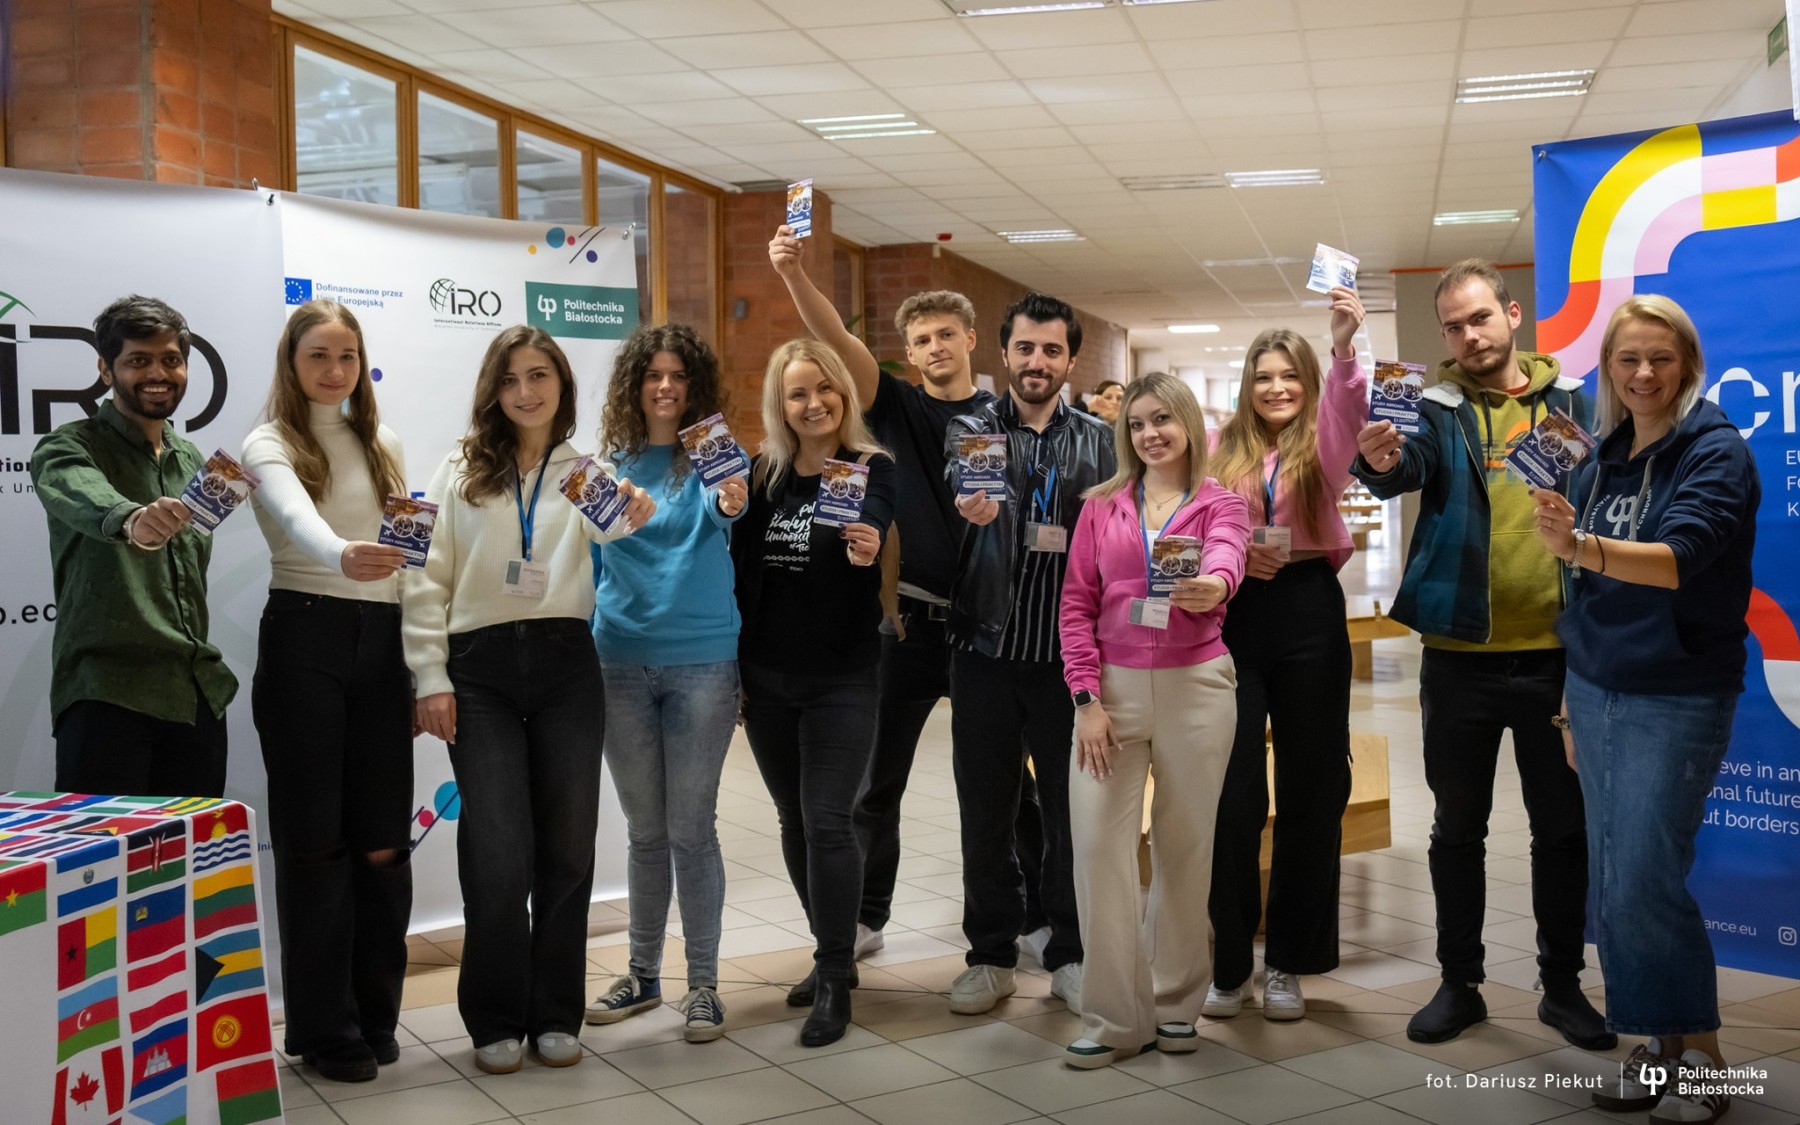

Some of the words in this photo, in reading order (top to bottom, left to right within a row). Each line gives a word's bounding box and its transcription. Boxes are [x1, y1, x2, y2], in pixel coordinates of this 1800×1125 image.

[316, 282, 380, 296] Dofinansowane
[381, 290, 403, 298] przez
[337, 295, 384, 308] Europejską
[564, 299, 625, 312] Politechnika
[565, 311, 623, 324] Białostocka
[1757, 760, 1773, 779] in
[1745, 786, 1800, 809] future
[1725, 809, 1800, 835] borders
